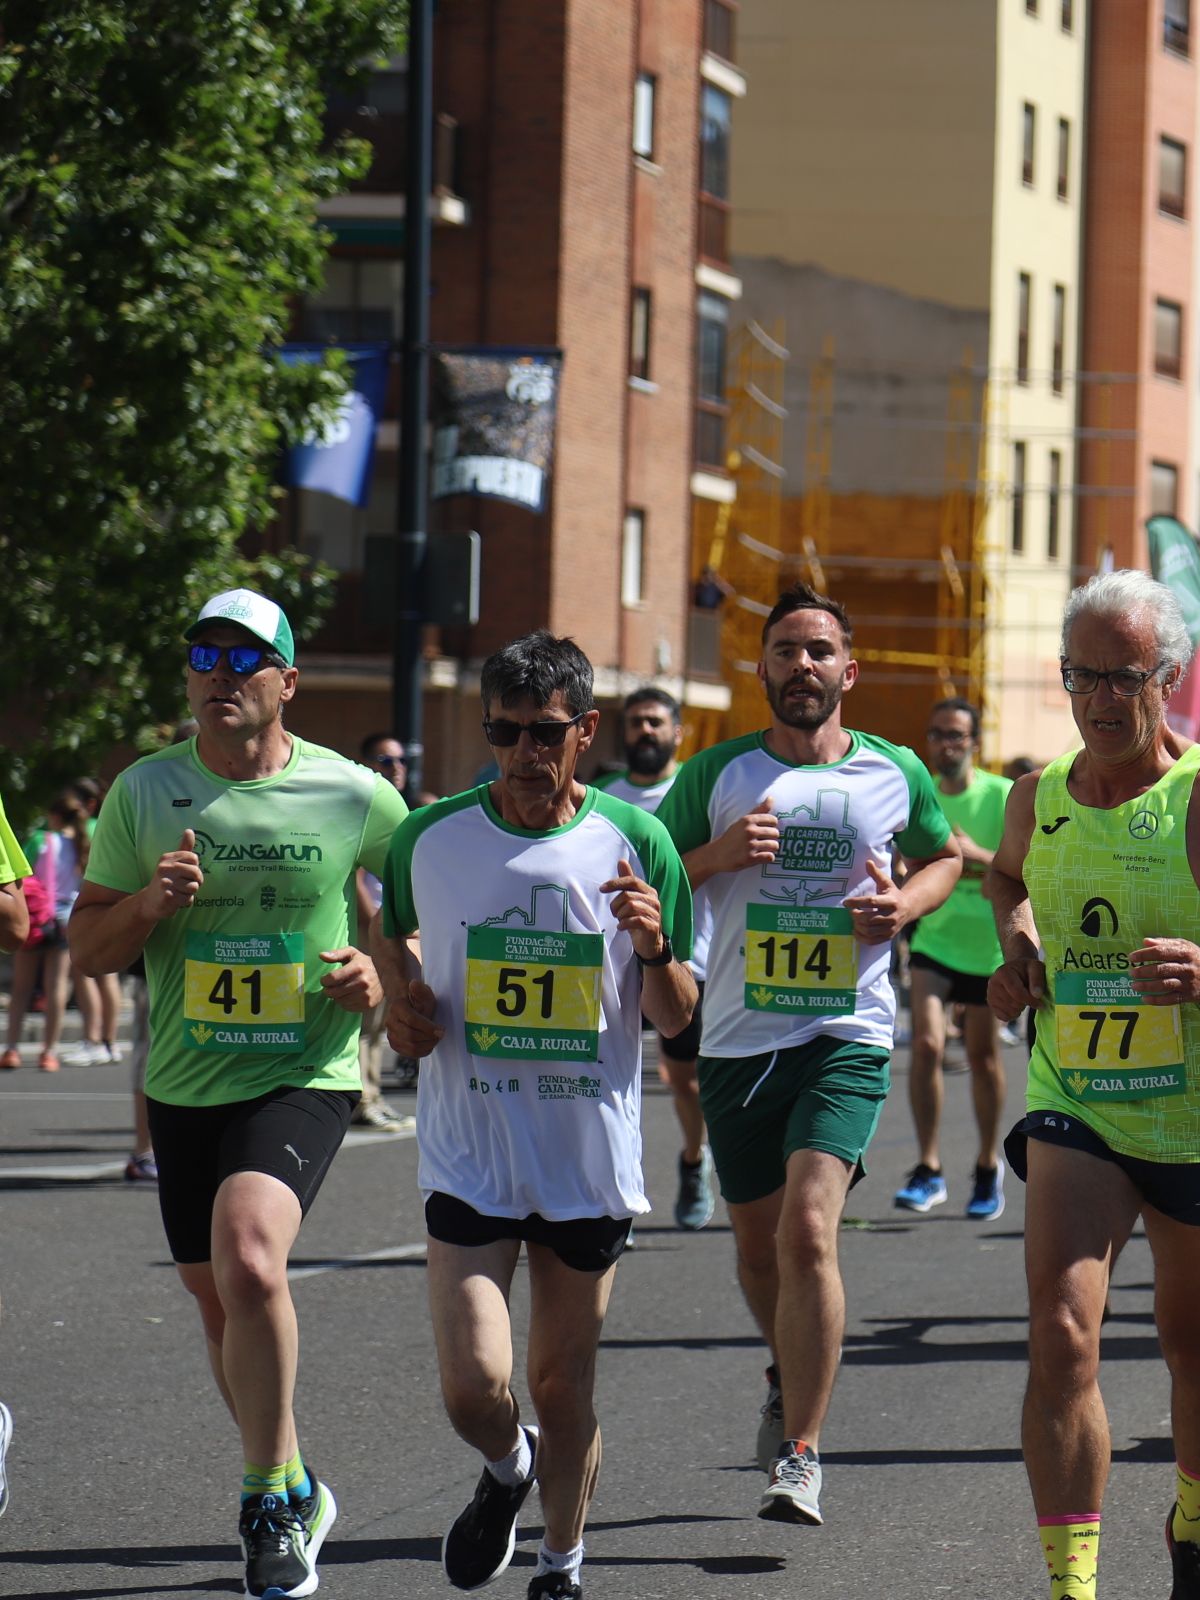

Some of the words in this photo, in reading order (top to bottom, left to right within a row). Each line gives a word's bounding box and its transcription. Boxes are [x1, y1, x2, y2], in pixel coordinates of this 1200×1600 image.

[796, 829, 834, 840] CARRERA
[793, 840, 850, 861] CERCO
[785, 859, 795, 868] DE
[797, 860, 831, 870] ZAMORA
[1112, 854, 1166, 865] Mercedes-Benz
[239, 865, 259, 873] Cross
[261, 865, 277, 873] Trail
[278, 865, 311, 873] Ricobayo
[1125, 865, 1150, 873] Adarsa
[800, 920, 829, 928] RURAL
[215, 948, 237, 957] CAJA
[240, 949, 271, 957] RURAL
[505, 944, 530, 955] CAJA
[532, 947, 567, 957] RURAL
[757, 936, 832, 981] 114
[208, 969, 261, 1015] 41
[496, 968, 554, 1019] 51
[1086, 988, 1108, 997] CAJA
[775, 994, 805, 1006] CAJA
[808, 996, 850, 1007] RURAL
[215, 1032, 249, 1044] CAJA
[252, 1032, 299, 1044] RURAL
[1078, 1012, 1139, 1060] 77
[500, 1036, 537, 1050] CAJA
[540, 1037, 590, 1051] RURAL
[1091, 1079, 1126, 1092] CAJA
[1129, 1074, 1179, 1089] RURAL
[538, 1083, 565, 1094] CAJA
[567, 1085, 601, 1097] RURAL
